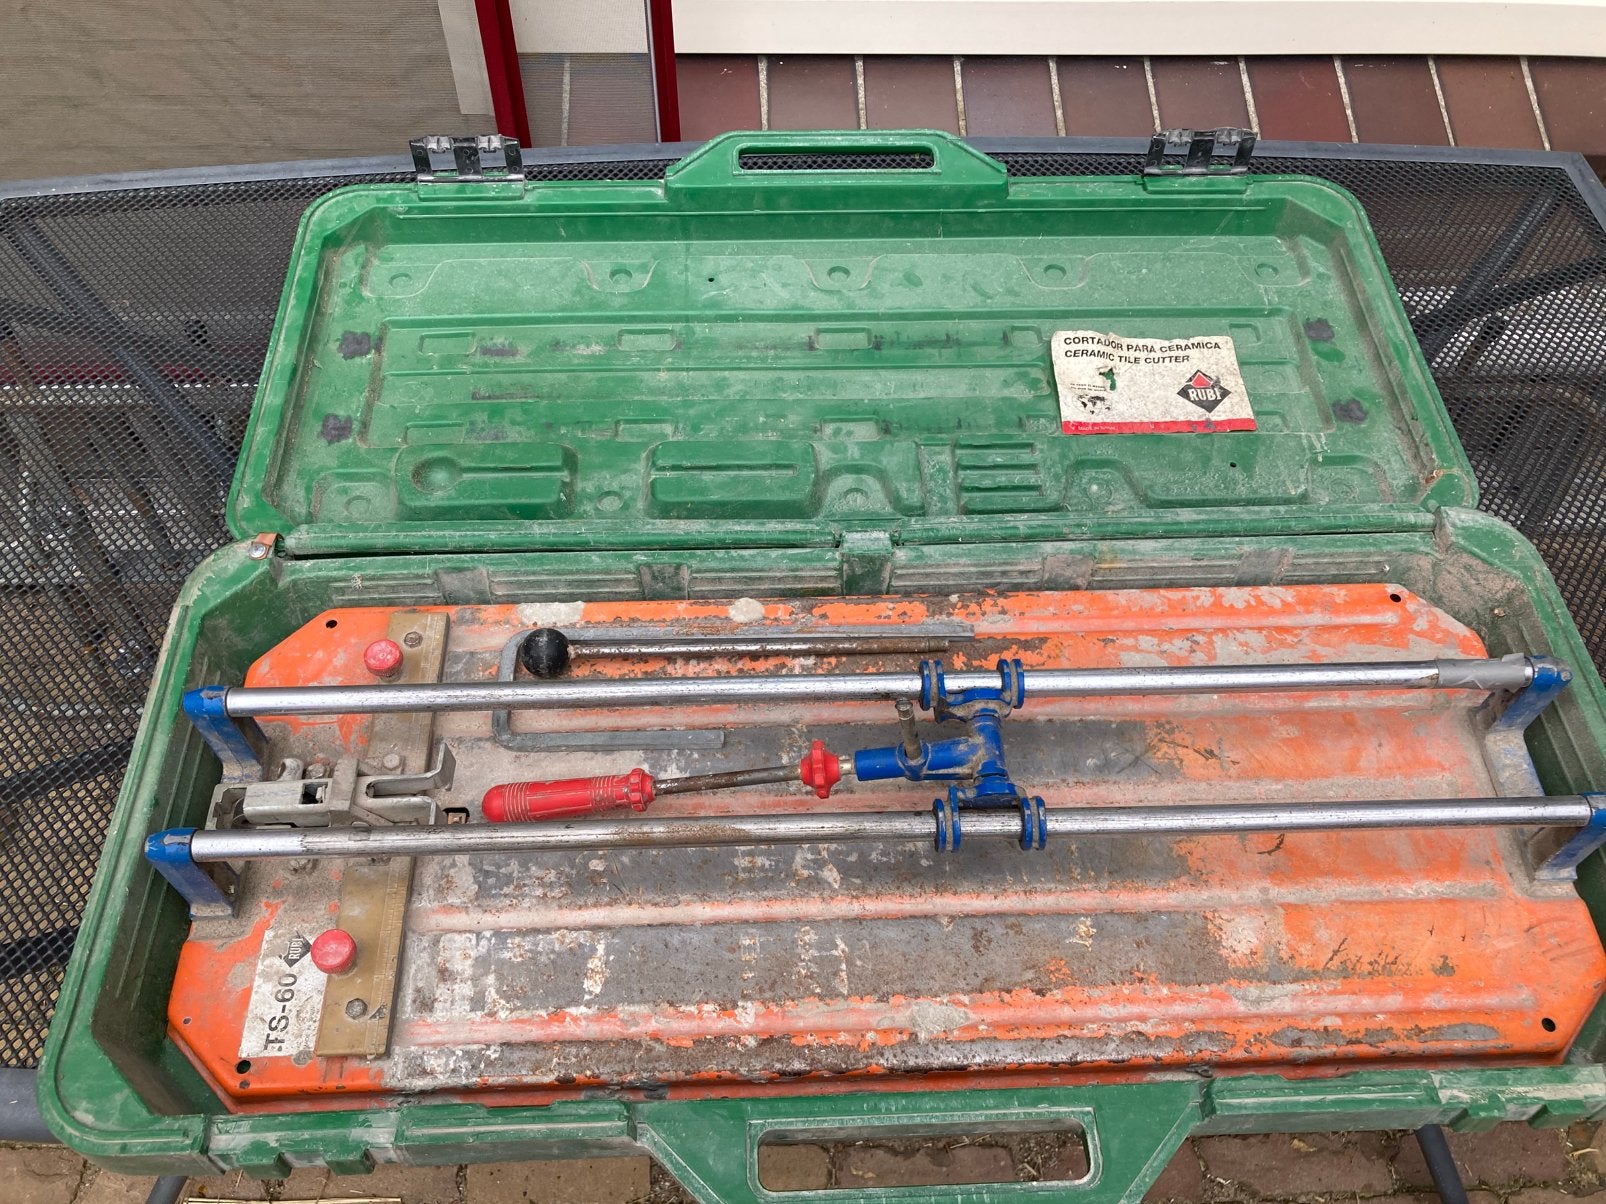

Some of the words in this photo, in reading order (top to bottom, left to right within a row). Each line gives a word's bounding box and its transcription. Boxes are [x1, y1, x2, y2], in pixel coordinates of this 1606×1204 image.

[1064, 336, 1123, 351] CORTADOR
[1126, 344, 1157, 353] PARA
[1159, 341, 1222, 353] CERAMICA
[1064, 349, 1115, 361] CERAMIC
[1117, 355, 1141, 364] TILE
[1144, 355, 1190, 364] CUTTER
[1187, 387, 1222, 401] RUBI
[288, 937, 304, 960] RUBI
[263, 973, 298, 1051] TS-60
